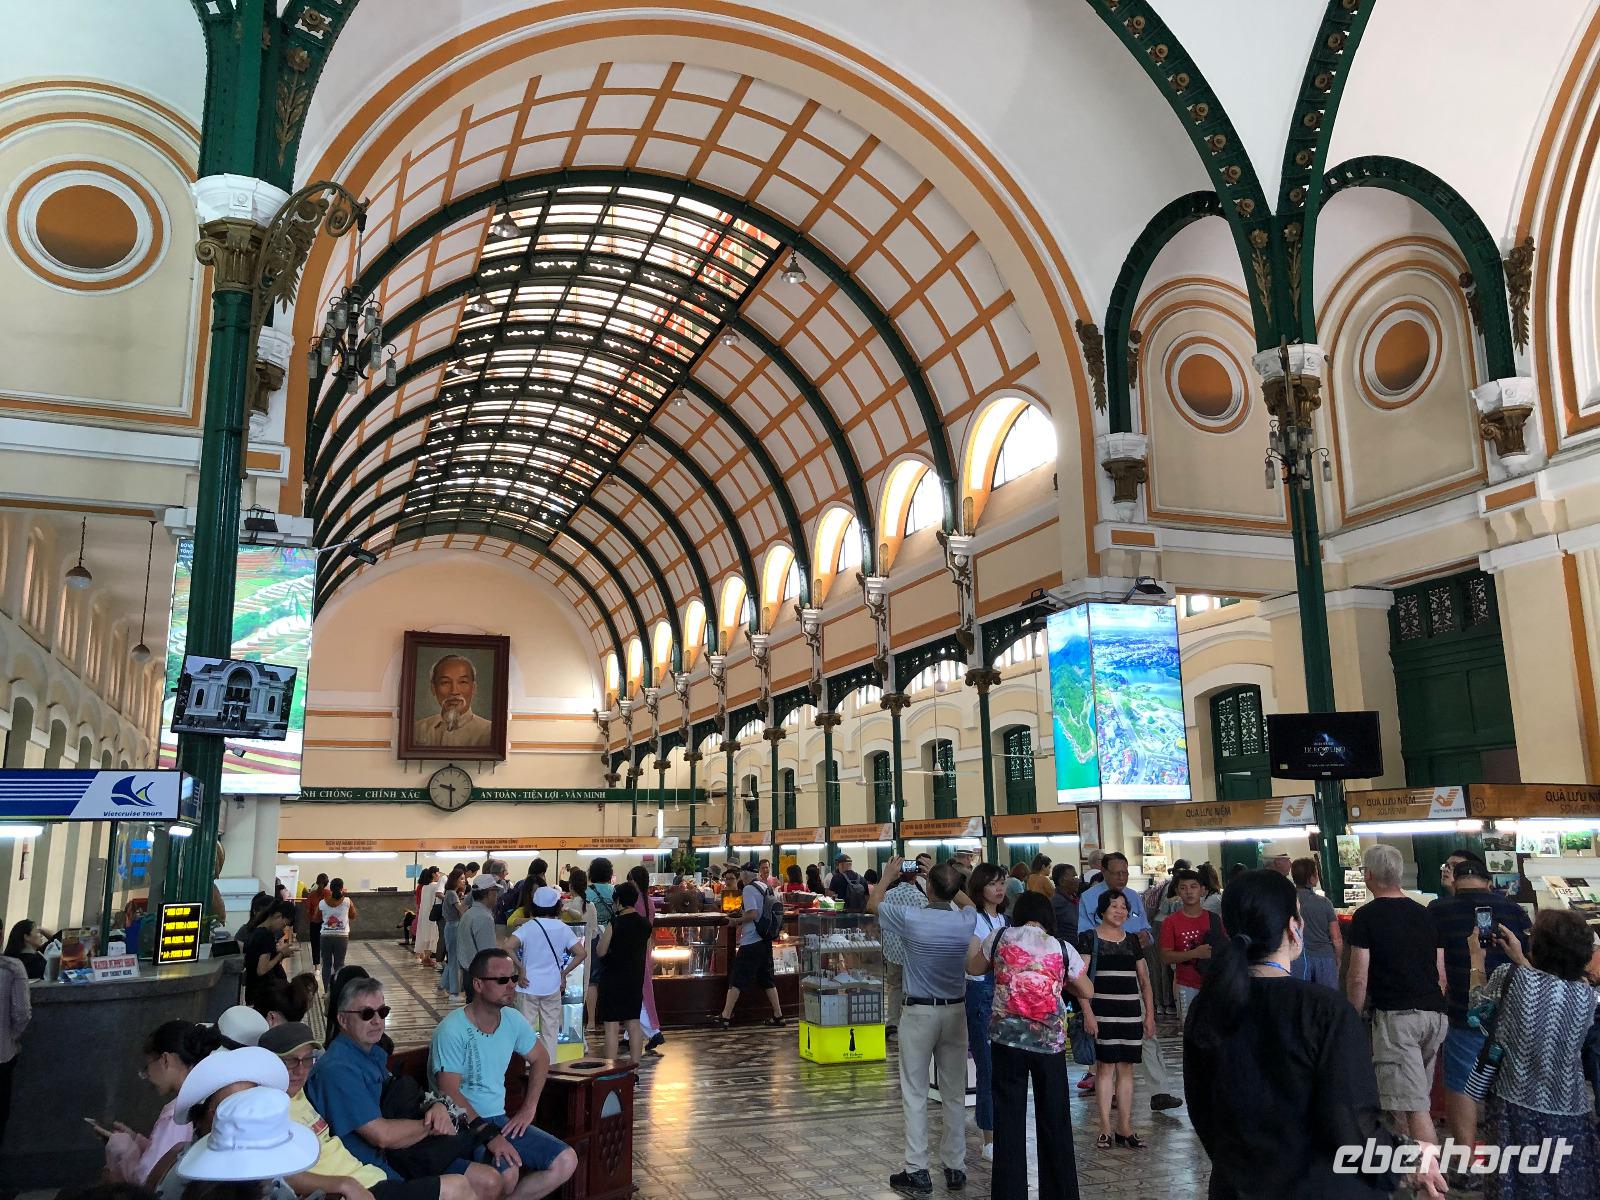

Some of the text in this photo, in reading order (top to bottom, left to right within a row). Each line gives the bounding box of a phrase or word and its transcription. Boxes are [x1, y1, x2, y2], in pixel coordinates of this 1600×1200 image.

[365, 788, 397, 798] CHÍNH
[481, 791, 492, 799] AN
[583, 791, 606, 799] MINH
